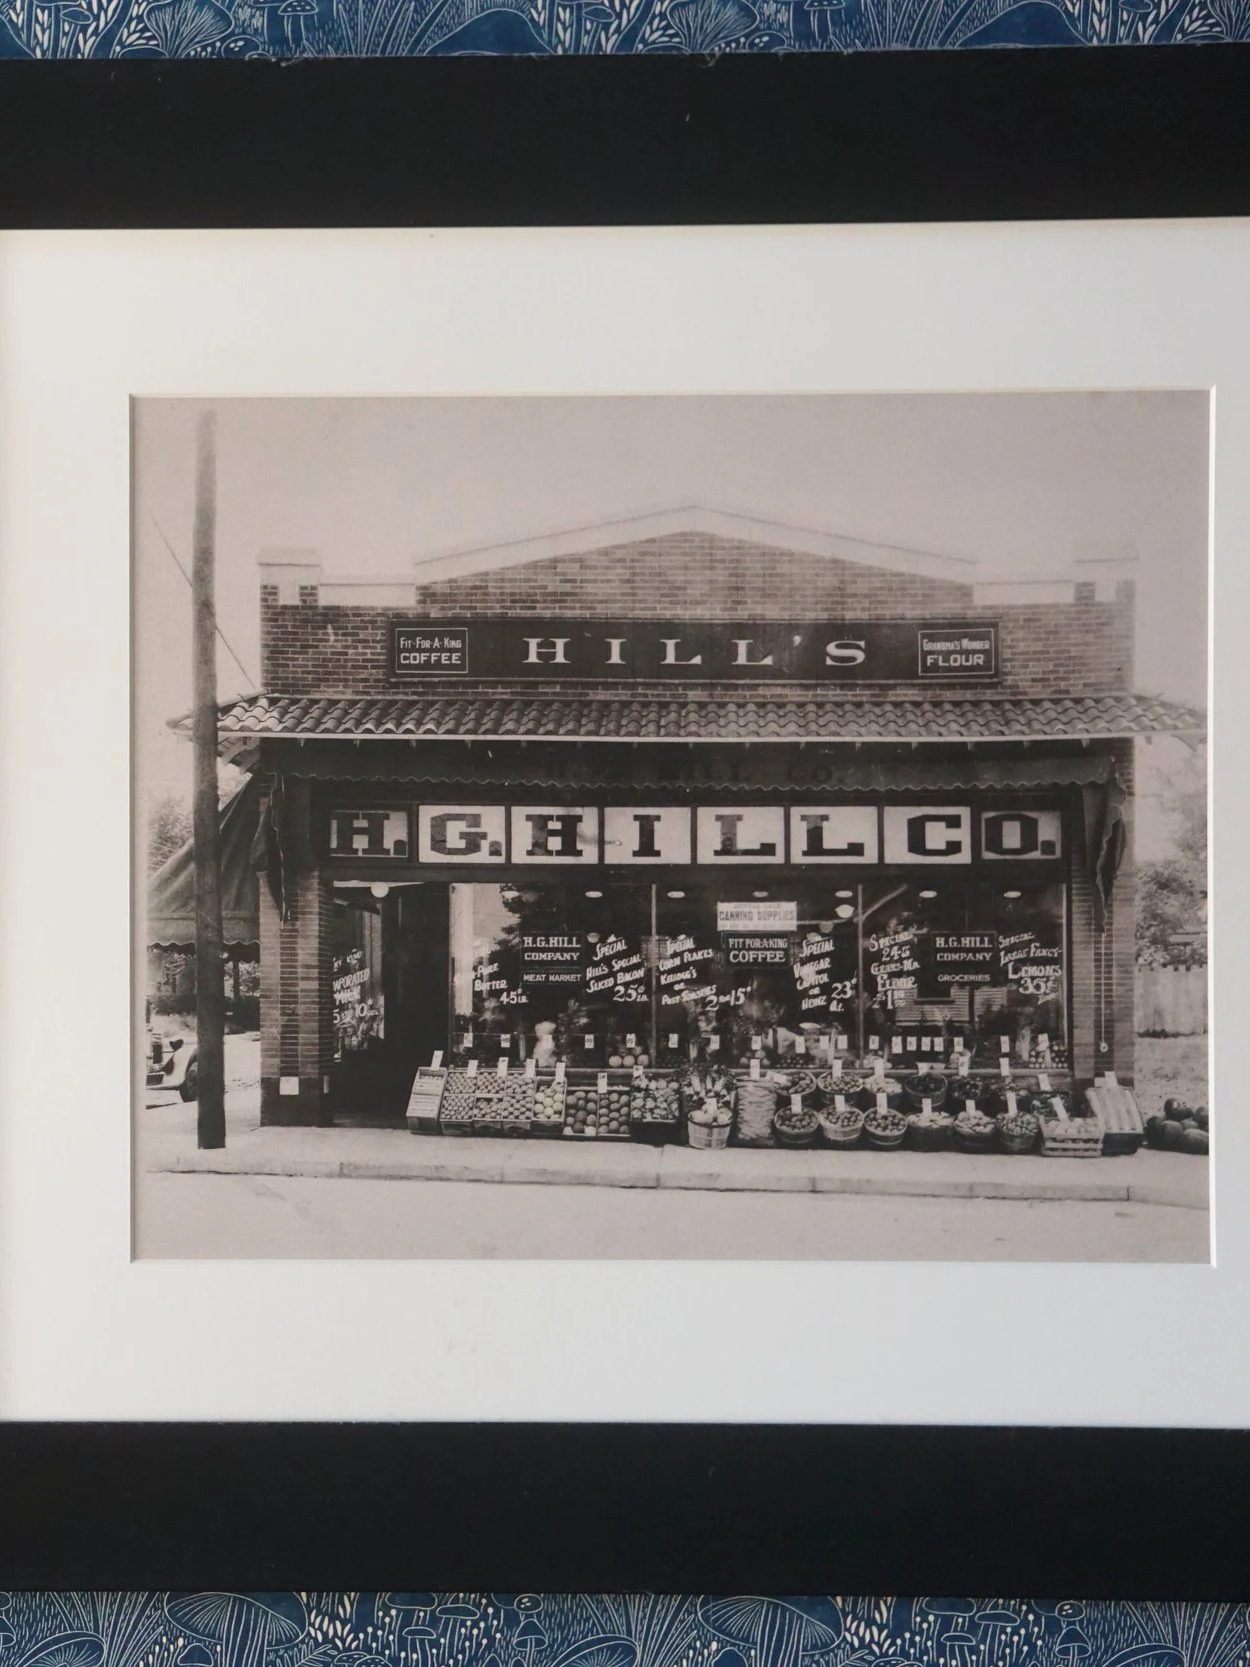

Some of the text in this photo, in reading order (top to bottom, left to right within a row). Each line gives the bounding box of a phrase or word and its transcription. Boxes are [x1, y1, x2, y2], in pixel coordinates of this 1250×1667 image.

[522, 635, 866, 665] HILL'S
[400, 653, 461, 664] COFFEE
[926, 654, 984, 666] FLOUR
[430, 813, 502, 856] G.
[525, 813, 865, 857] HILL
[907, 813, 1056, 857] CO.
[728, 938, 744, 949] FIT
[524, 952, 580, 961] COMPANY
[729, 950, 786, 963] COFFEE
[936, 952, 992, 961] COMPANY
[523, 974, 582, 982] MEAT MARKET
[937, 974, 991, 982] GROCERIES
